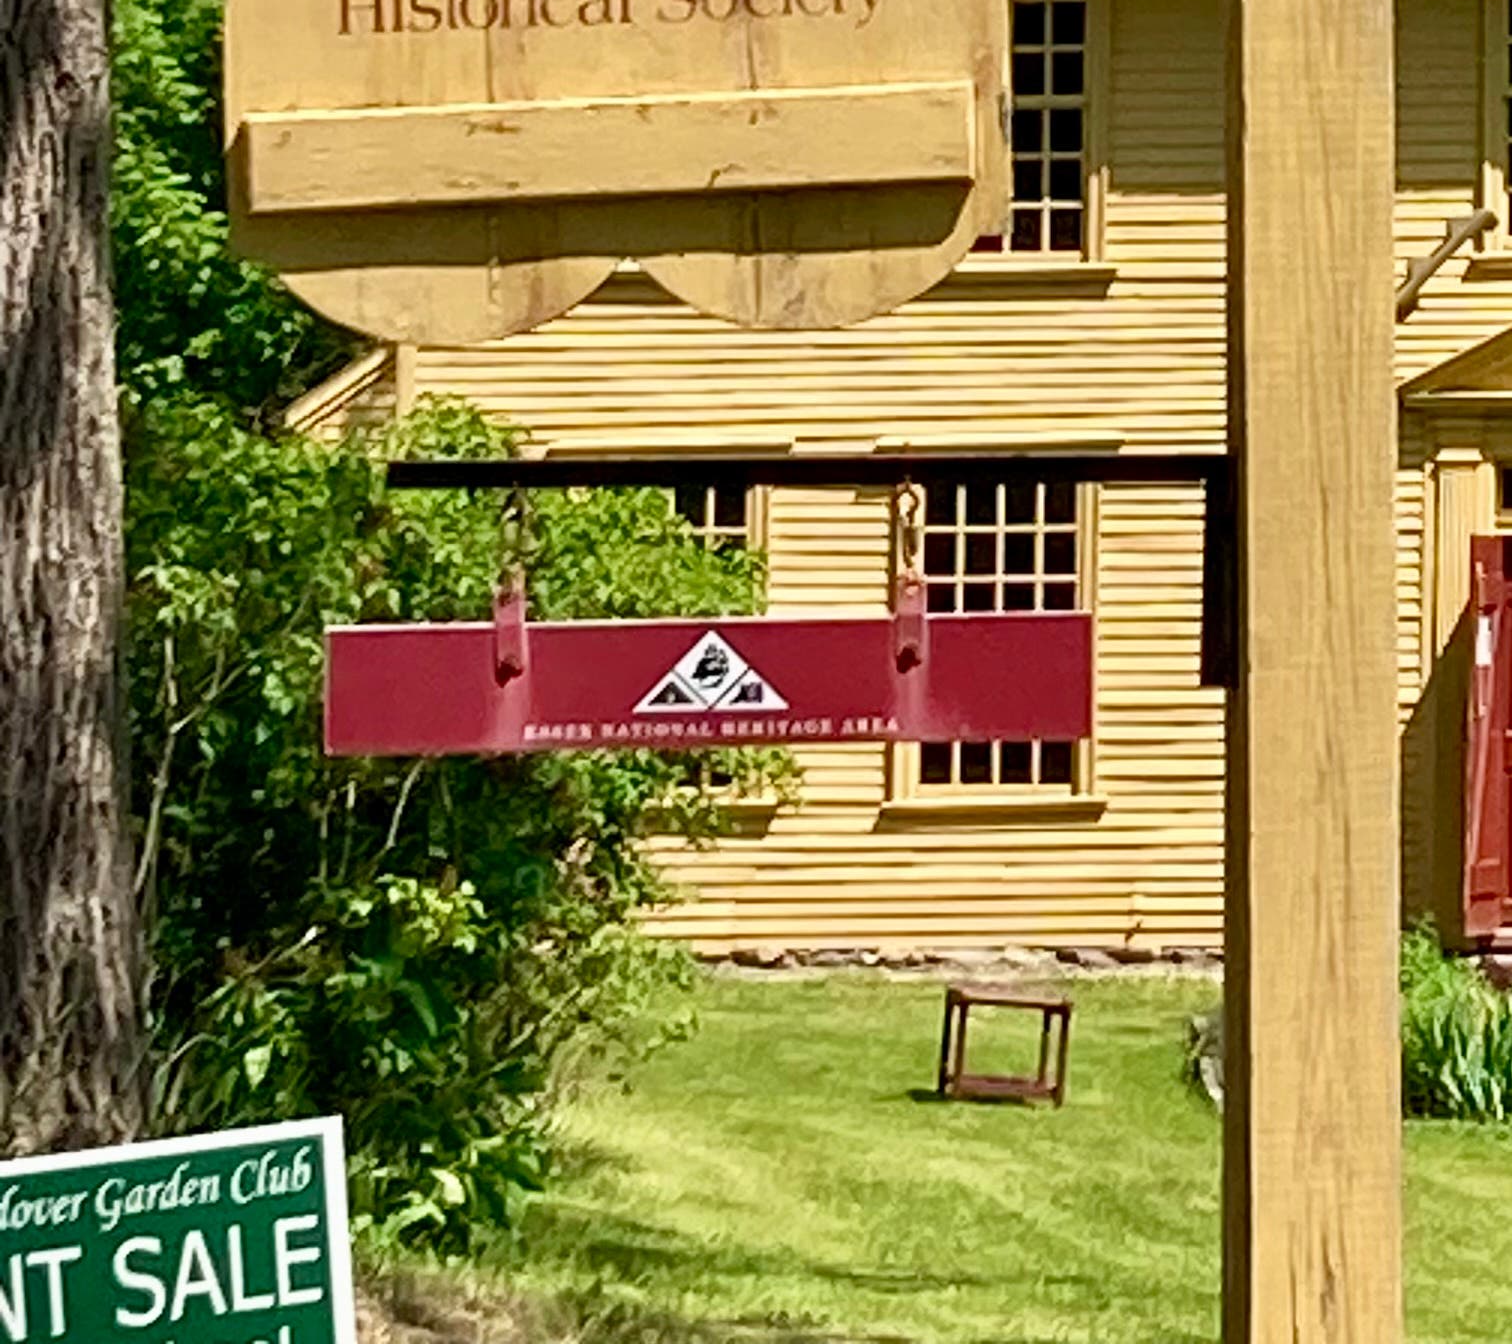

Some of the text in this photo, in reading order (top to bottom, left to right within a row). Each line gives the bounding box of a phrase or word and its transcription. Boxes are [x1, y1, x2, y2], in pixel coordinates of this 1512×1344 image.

[601, 722, 713, 738] NATIONAL
[720, 719, 831, 737] HERITAGE
[841, 716, 899, 735] AREA
[94, 1162, 220, 1232] Garden
[230, 1145, 312, 1205] Club
[112, 1214, 323, 1327] SALE
